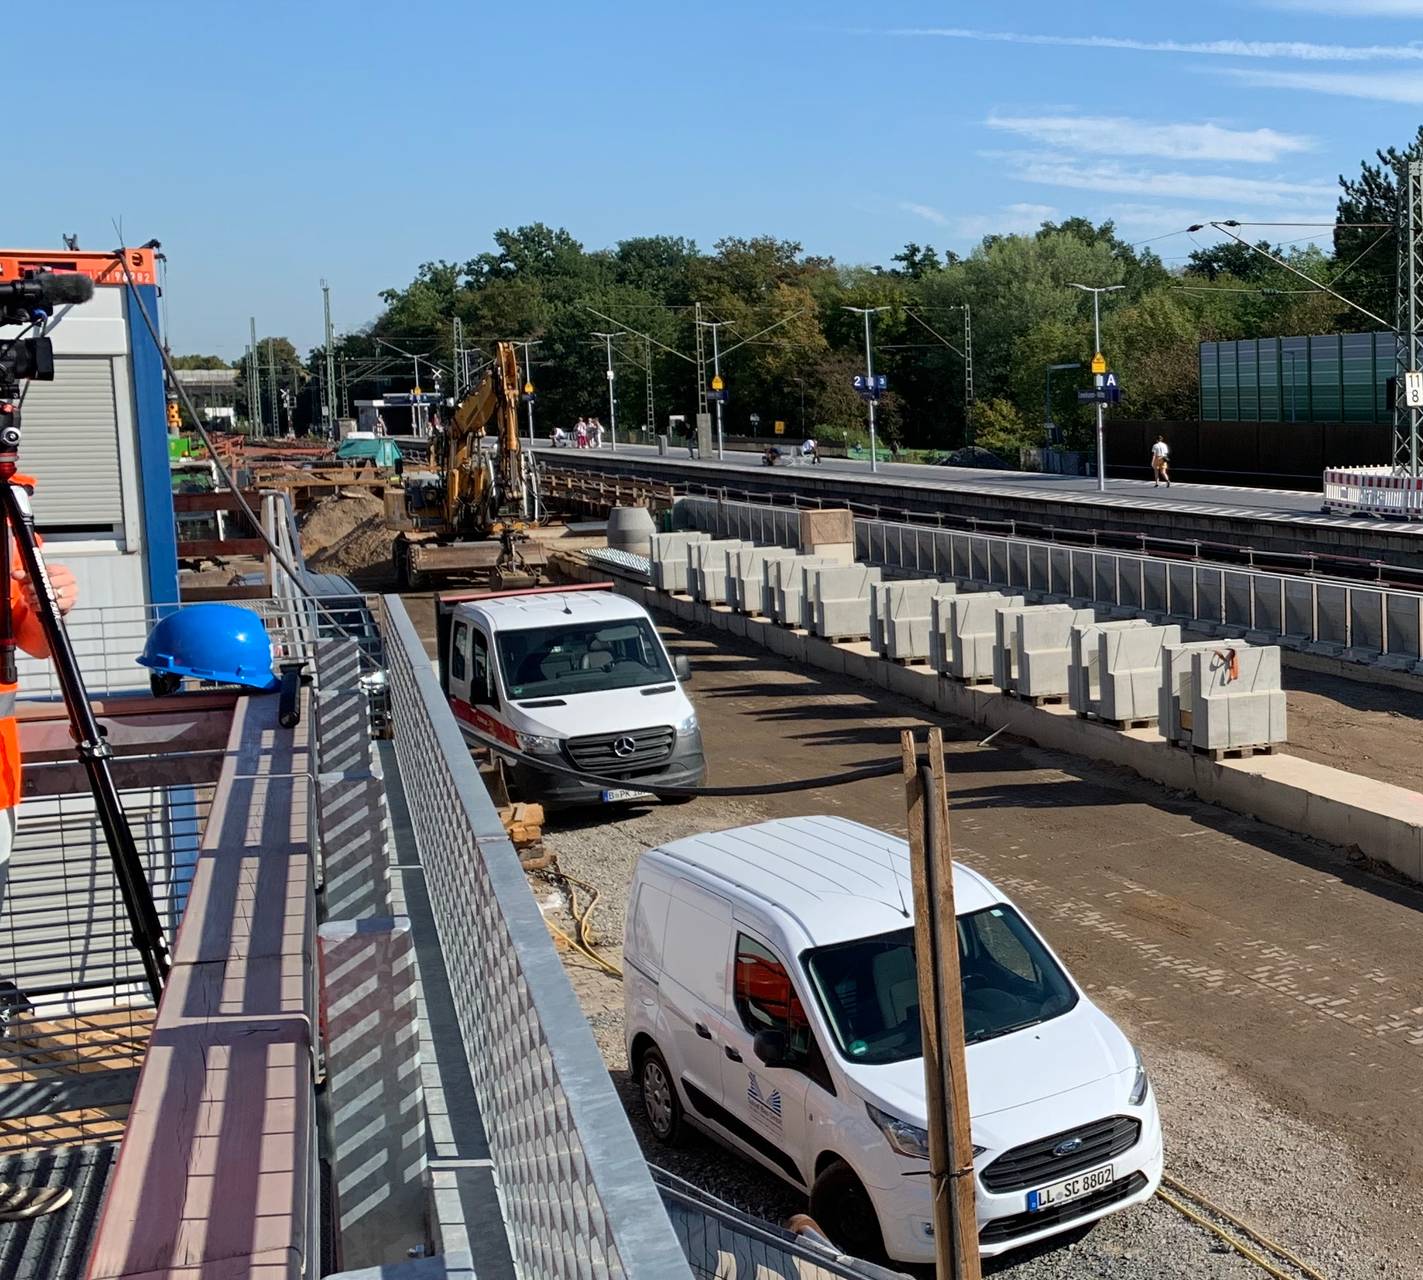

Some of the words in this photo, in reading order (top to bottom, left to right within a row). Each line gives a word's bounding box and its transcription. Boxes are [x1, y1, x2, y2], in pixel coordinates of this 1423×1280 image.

[854, 375, 861, 386] 2
[1106, 373, 1117, 386] A
[1409, 374, 1420, 388] 11
[1411, 389, 1419, 403] 8
[1038, 1189, 1055, 1206] LL
[1064, 1180, 1080, 1198] SC
[1082, 1168, 1112, 1191] 8802
